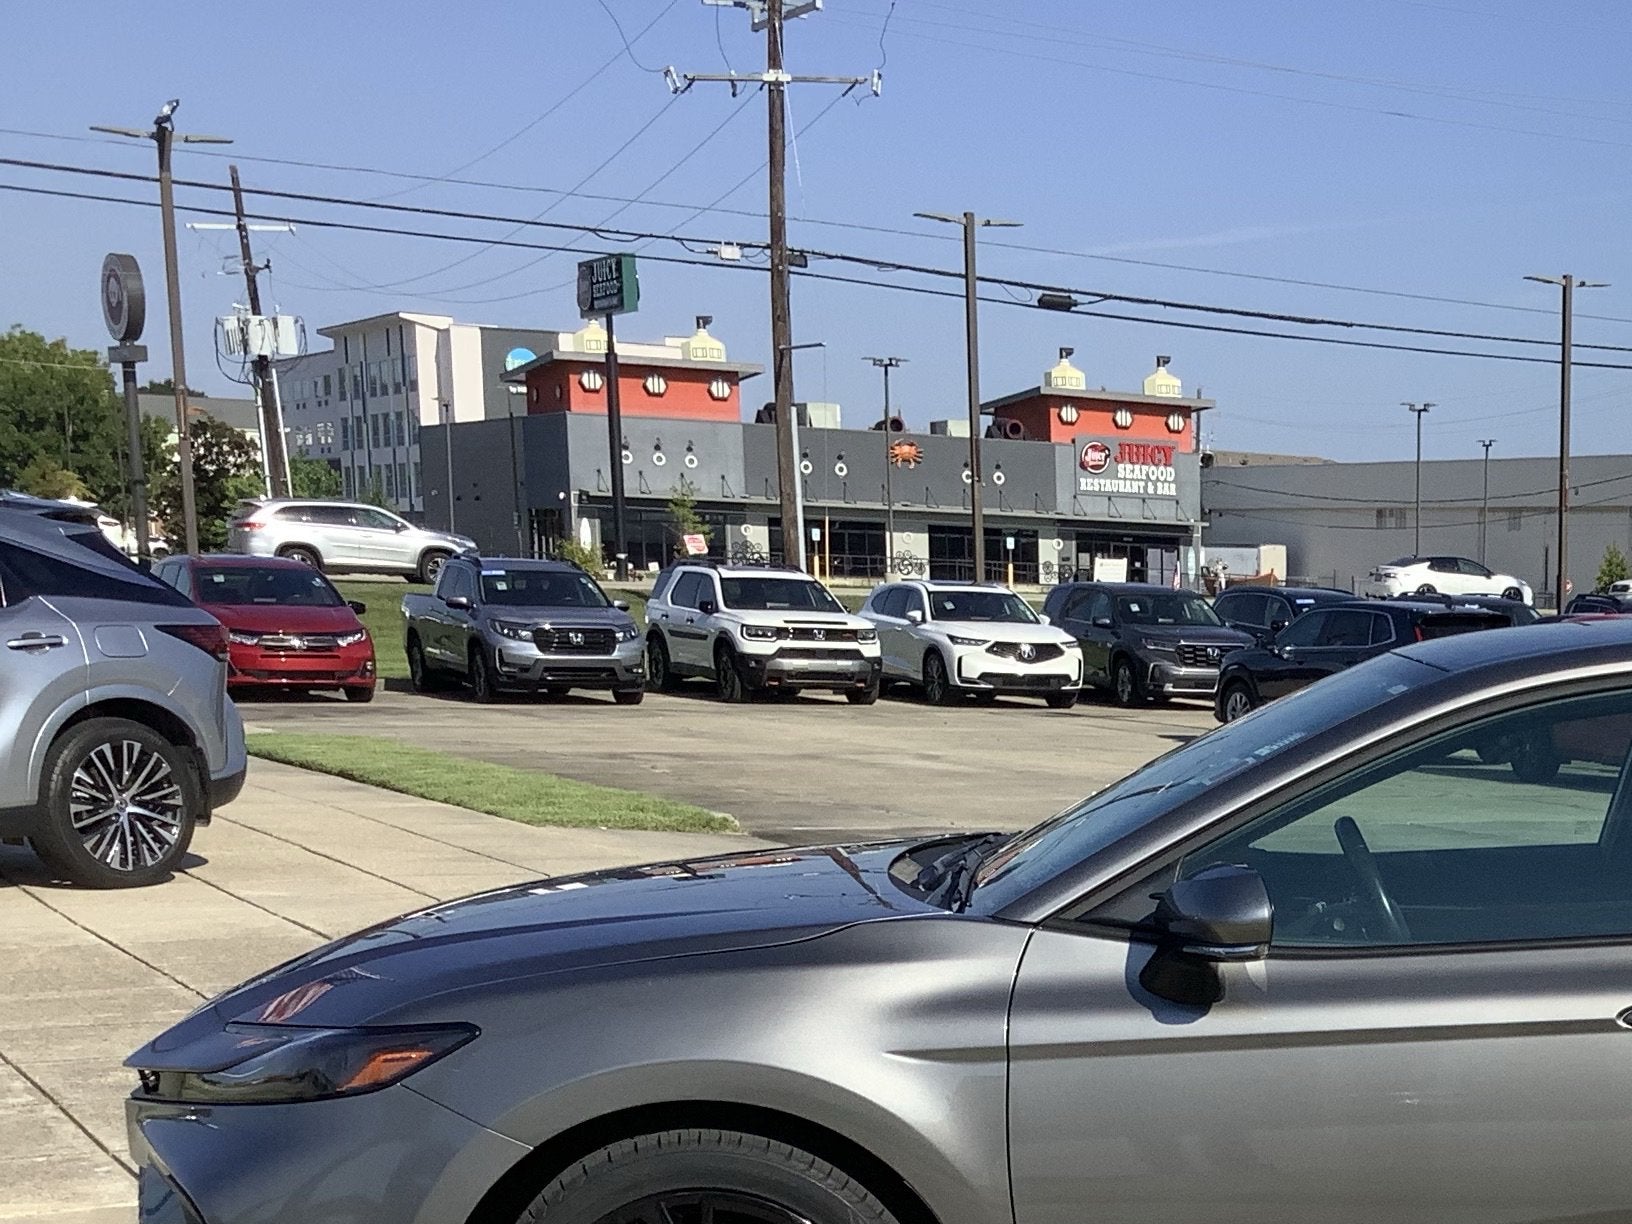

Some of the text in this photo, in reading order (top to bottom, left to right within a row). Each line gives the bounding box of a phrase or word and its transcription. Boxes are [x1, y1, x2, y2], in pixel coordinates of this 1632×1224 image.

[1114, 442, 1175, 466] JUICY
[1117, 464, 1175, 481] SEAFOOD
[1080, 478, 1176, 496] RESTAURANT & BAR
